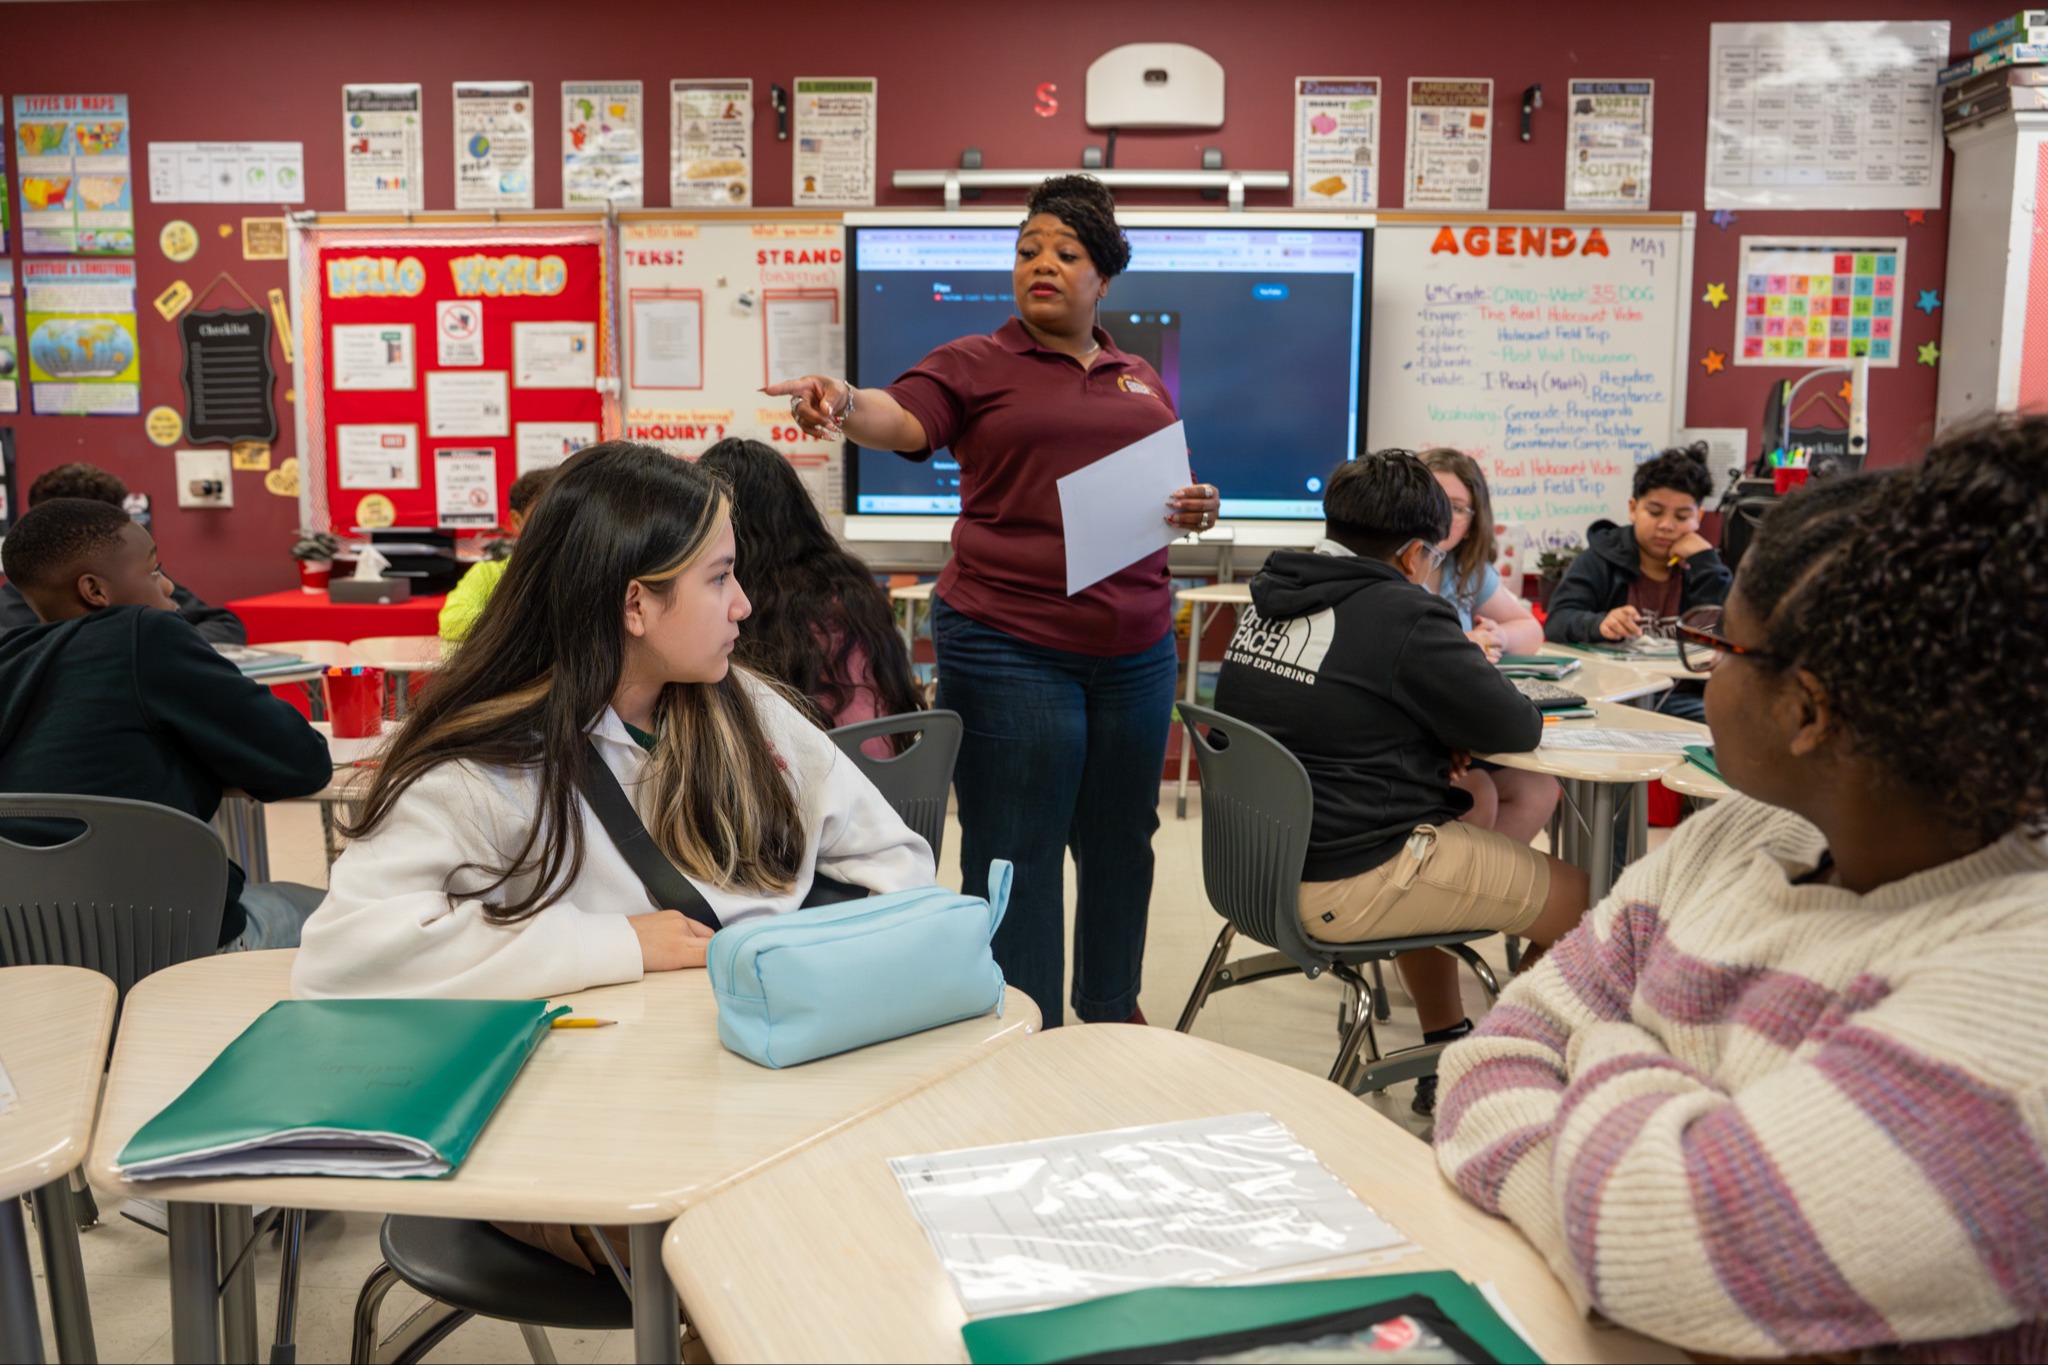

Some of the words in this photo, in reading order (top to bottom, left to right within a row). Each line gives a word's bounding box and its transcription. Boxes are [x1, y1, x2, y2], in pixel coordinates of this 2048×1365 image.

[1419, 84, 1482, 92] AMERICAN
[26, 96, 60, 112] TYPES
[64, 96, 78, 112] OF
[82, 96, 115, 112] MAPS
[1034, 83, 1058, 117] S
[1595, 98, 1640, 107] NORTH
[1578, 162, 1639, 176] SOUTH
[1431, 226, 1610, 257] AGENDA
[625, 249, 684, 266] TEKS:
[756, 249, 843, 266] STRAND
[327, 256, 426, 298] HELLO
[449, 253, 568, 297] WORLD
[1510, 304, 1541, 322] Real
[199, 323, 251, 337] Checklist
[627, 425, 708, 440] INQUIRY
[1230, 625, 1281, 658] FACE
[1233, 652, 1252, 666] STOP
[1253, 657, 1316, 685] EXPLORING
